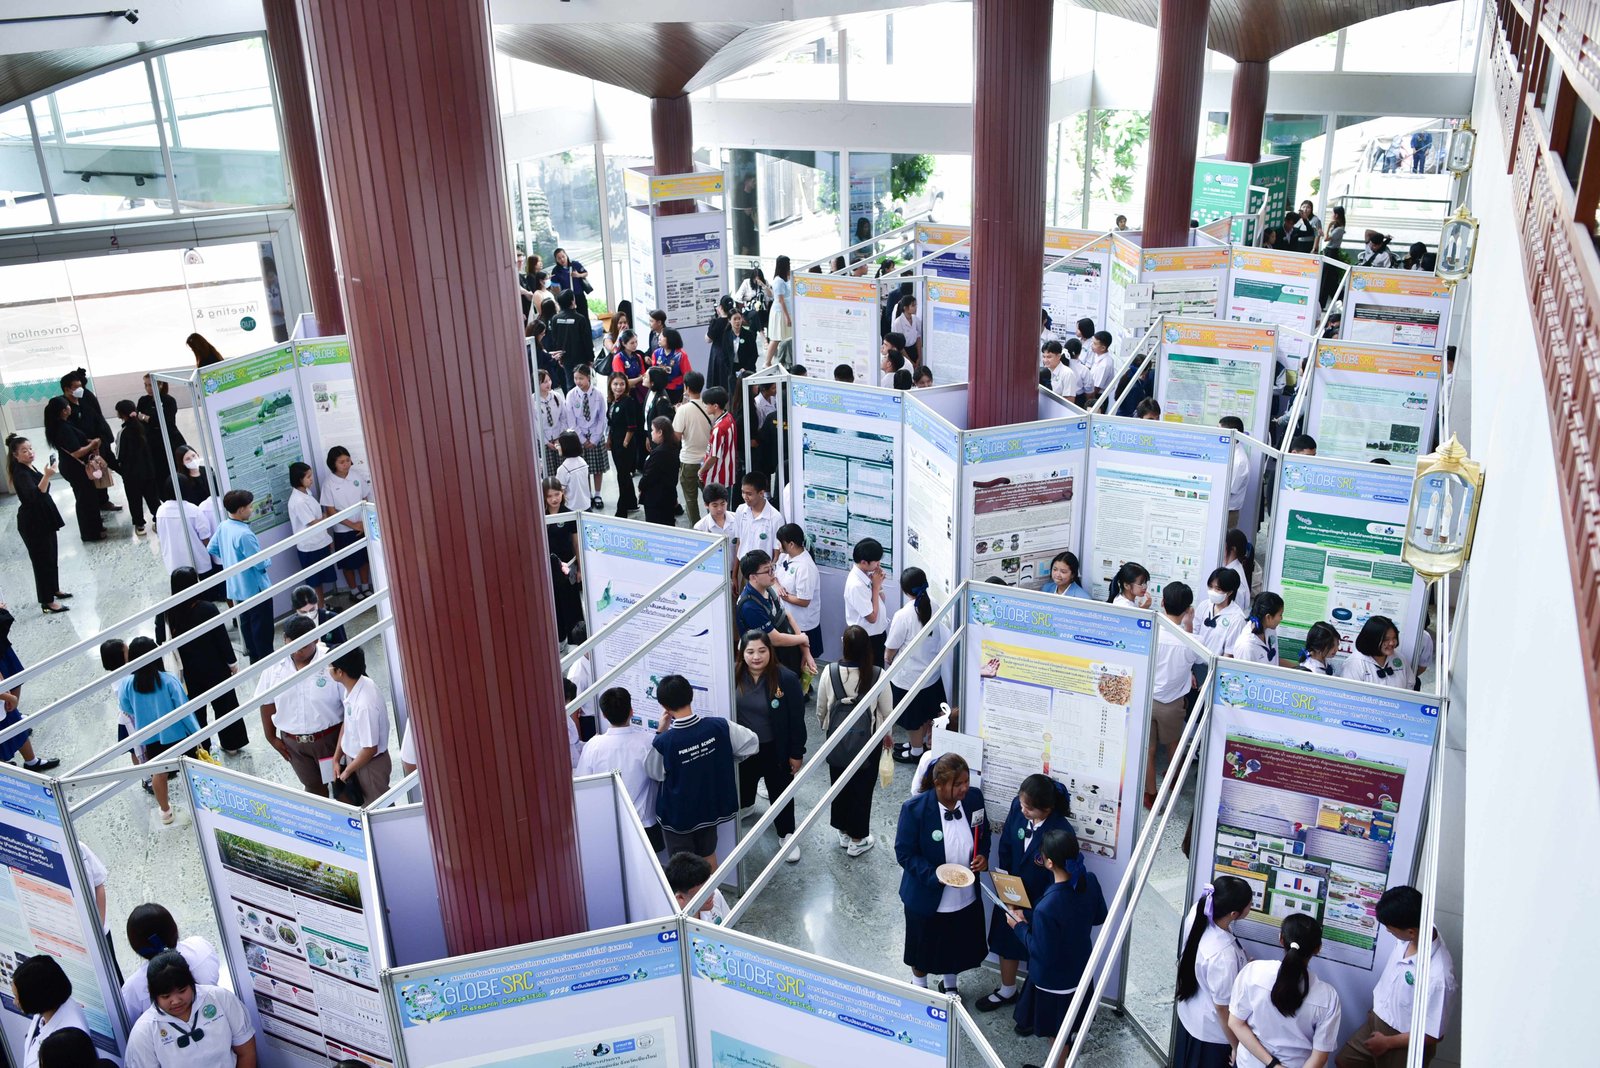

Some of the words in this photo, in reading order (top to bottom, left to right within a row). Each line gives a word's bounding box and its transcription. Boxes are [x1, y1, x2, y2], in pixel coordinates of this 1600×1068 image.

[110, 236, 118, 246] 2
[1111, 431, 1138, 445] GLOBE
[982, 441, 1008, 454] GLOBE
[1305, 472, 1336, 487] GLOBE
[1336, 476, 1356, 490] SRC
[604, 533, 631, 549] GLOBE
[995, 605, 1030, 624] GLOBE
[1031, 610, 1053, 628] SRC
[1247, 684, 1290, 706] GLOBE
[1291, 692, 1316, 711] SRC
[1425, 707, 1437, 715] 16
[701, 737, 716, 747] SCHOOL
[216, 789, 251, 813] GLOBE
[249, 799, 272, 820] SRC
[350, 820, 362, 829] 02
[662, 931, 677, 941] 04
[726, 957, 775, 988] GLOBE
[776, 972, 805, 998] SRC
[443, 977, 501, 1005] GLOBE
[501, 970, 534, 995] SRC
[739, 981, 773, 998] Research
[461, 1001, 498, 1012] Research
[502, 992, 547, 1005] Competition
[931, 1008, 946, 1019] 05
